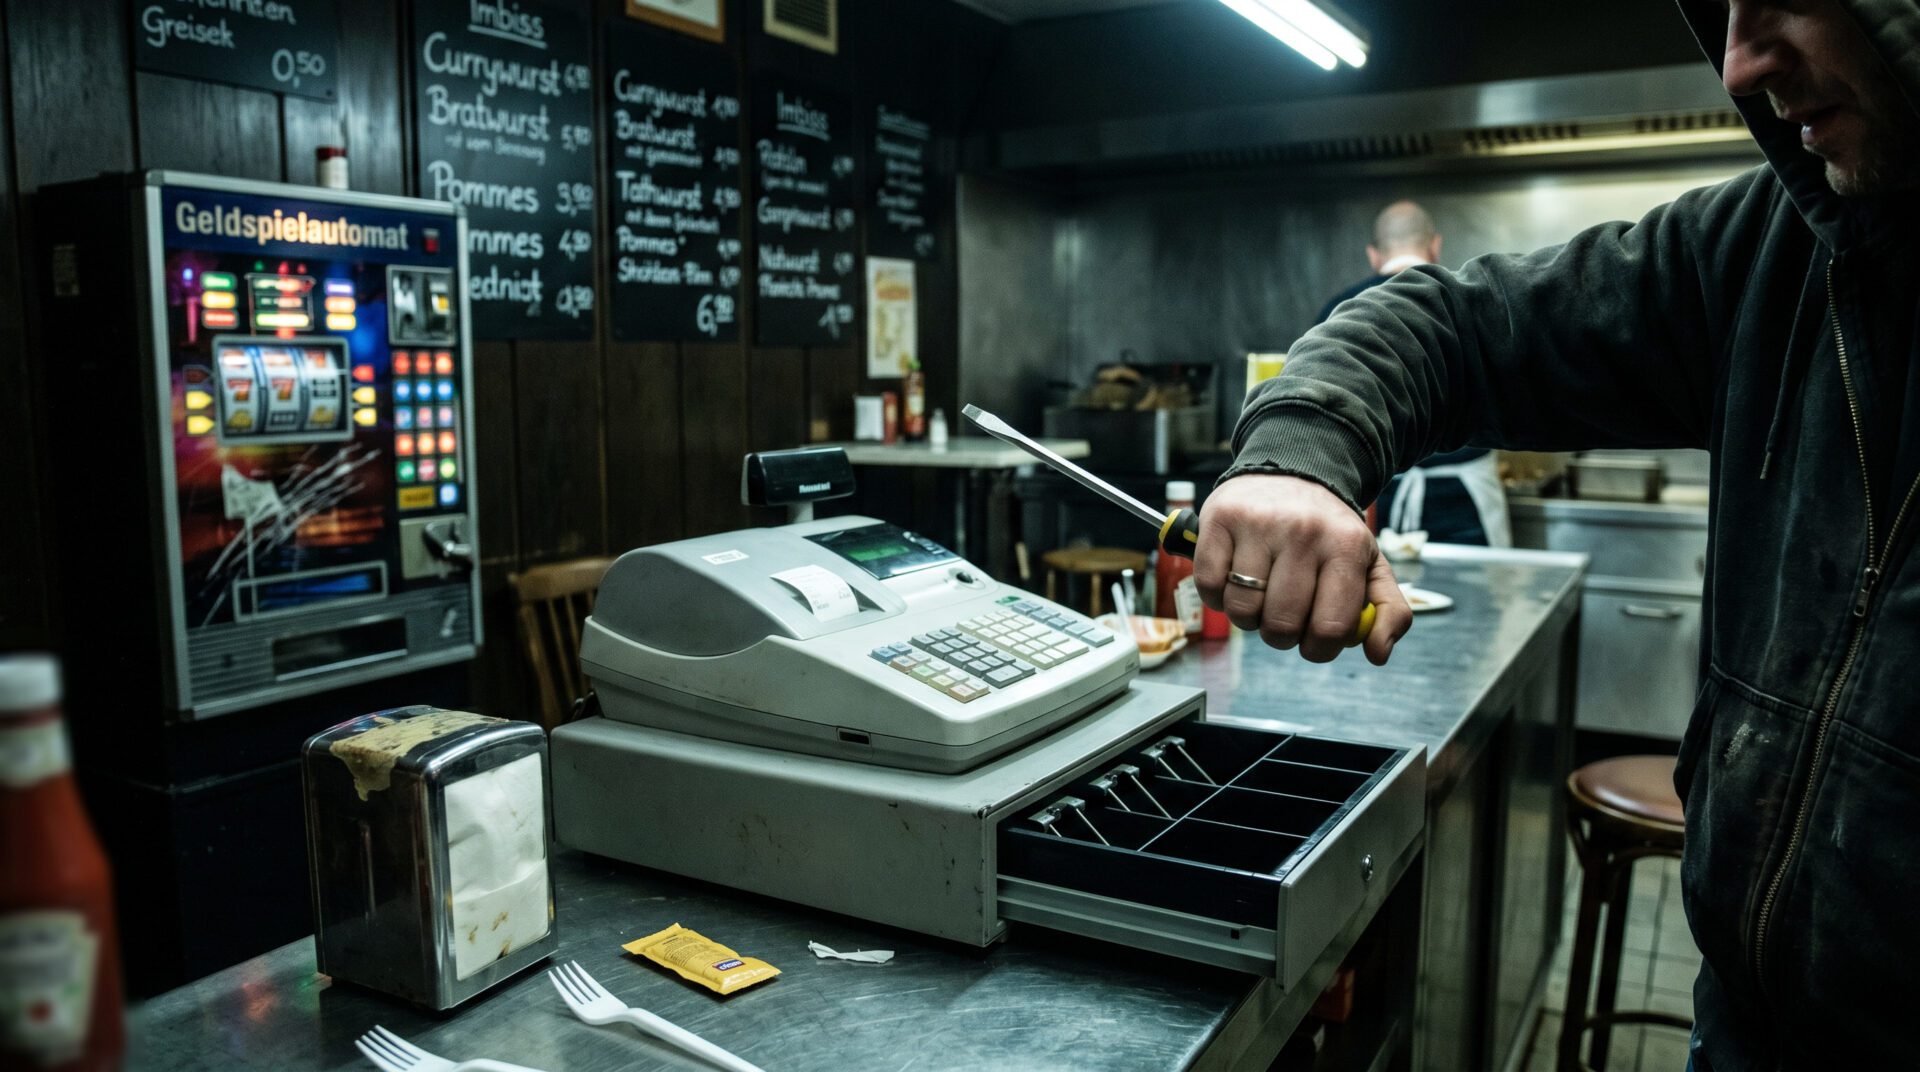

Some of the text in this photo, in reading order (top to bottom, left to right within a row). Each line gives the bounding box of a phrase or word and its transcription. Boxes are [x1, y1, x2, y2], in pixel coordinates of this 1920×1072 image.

[142, 5, 235, 47] Greisek
[471, 0, 544, 39] Imbiss
[272, 49, 326, 88] 0,50
[424, 31, 561, 97] Currywurst
[426, 84, 550, 141] Bratwurst
[614, 69, 706, 118] Currywurst
[614, 109, 696, 150] Bratwurst
[428, 161, 540, 214] Pommes
[176, 201, 409, 250] Geldspielautomat
[468, 228, 545, 260] mmes
